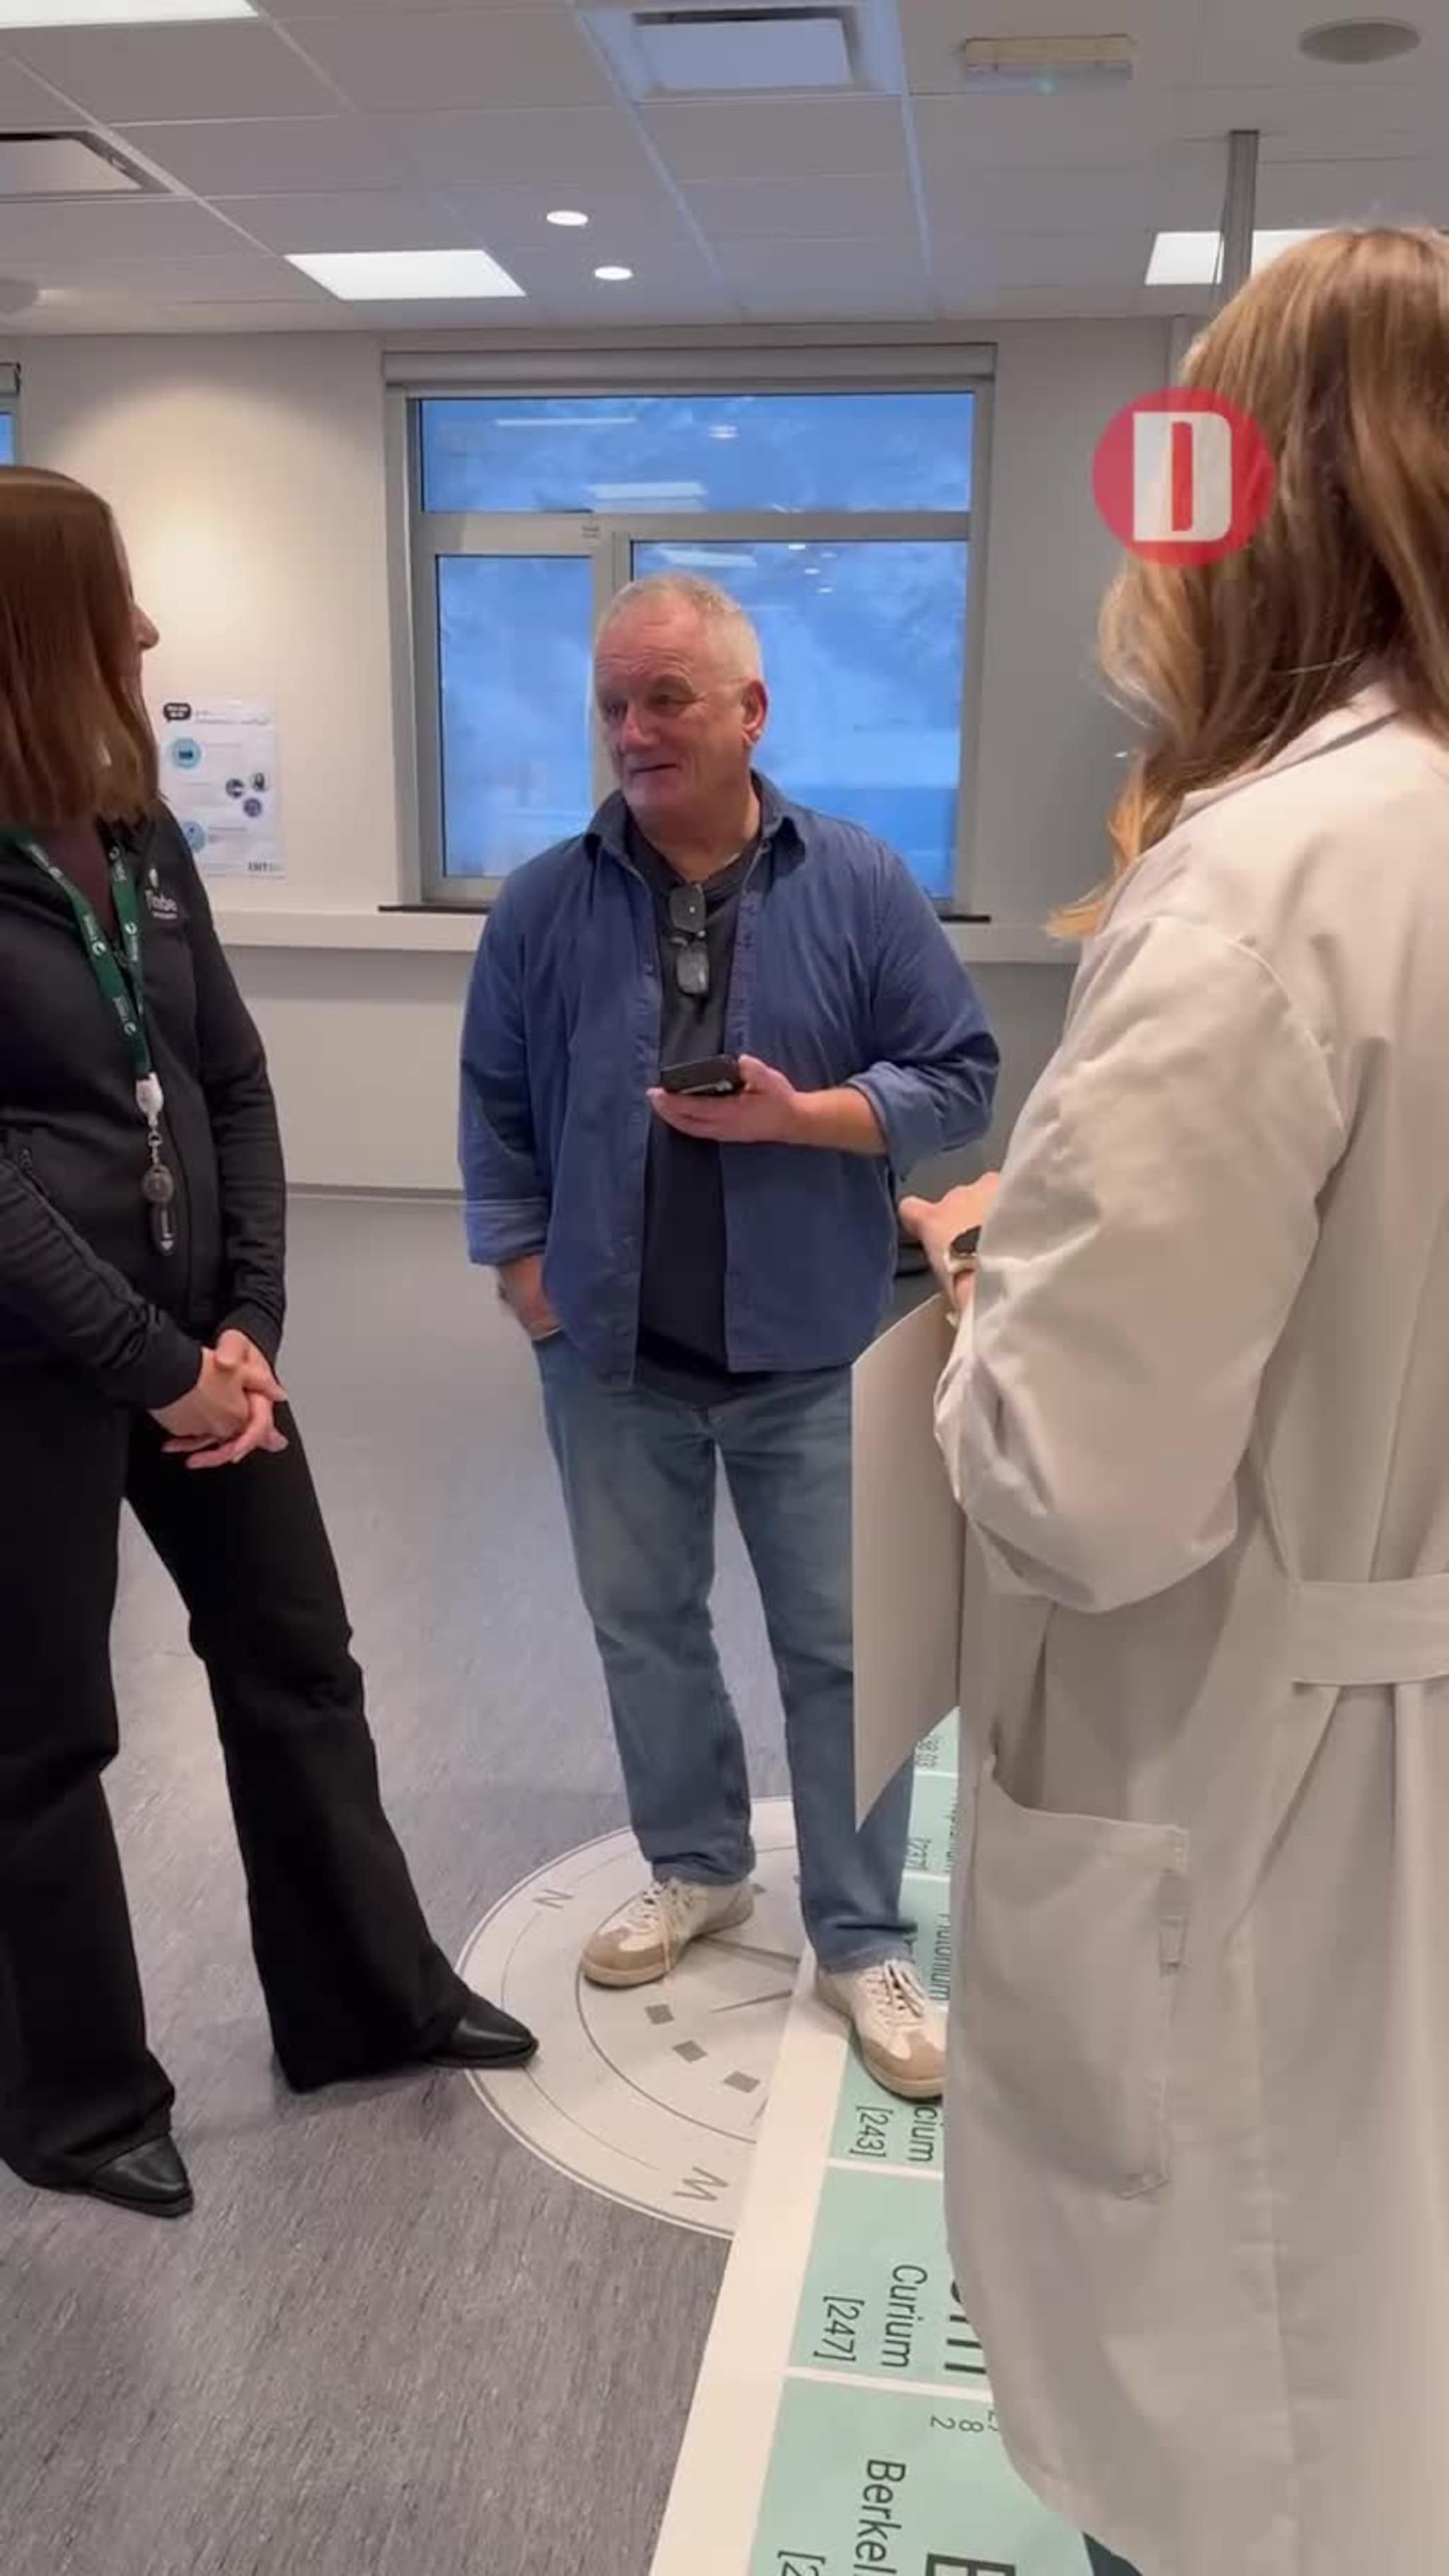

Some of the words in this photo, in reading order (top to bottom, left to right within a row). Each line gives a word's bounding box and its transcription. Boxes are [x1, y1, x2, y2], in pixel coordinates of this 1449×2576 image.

[849, 2106, 894, 2157] [243]
[907, 2106, 944, 2162] cium
[813, 2296, 865, 2362] [247]
[880, 2264, 928, 2368] Curium
[930, 2415, 955, 2430] 2
[958, 2420, 984, 2432] 8
[853, 2459, 907, 2576] Berkel
